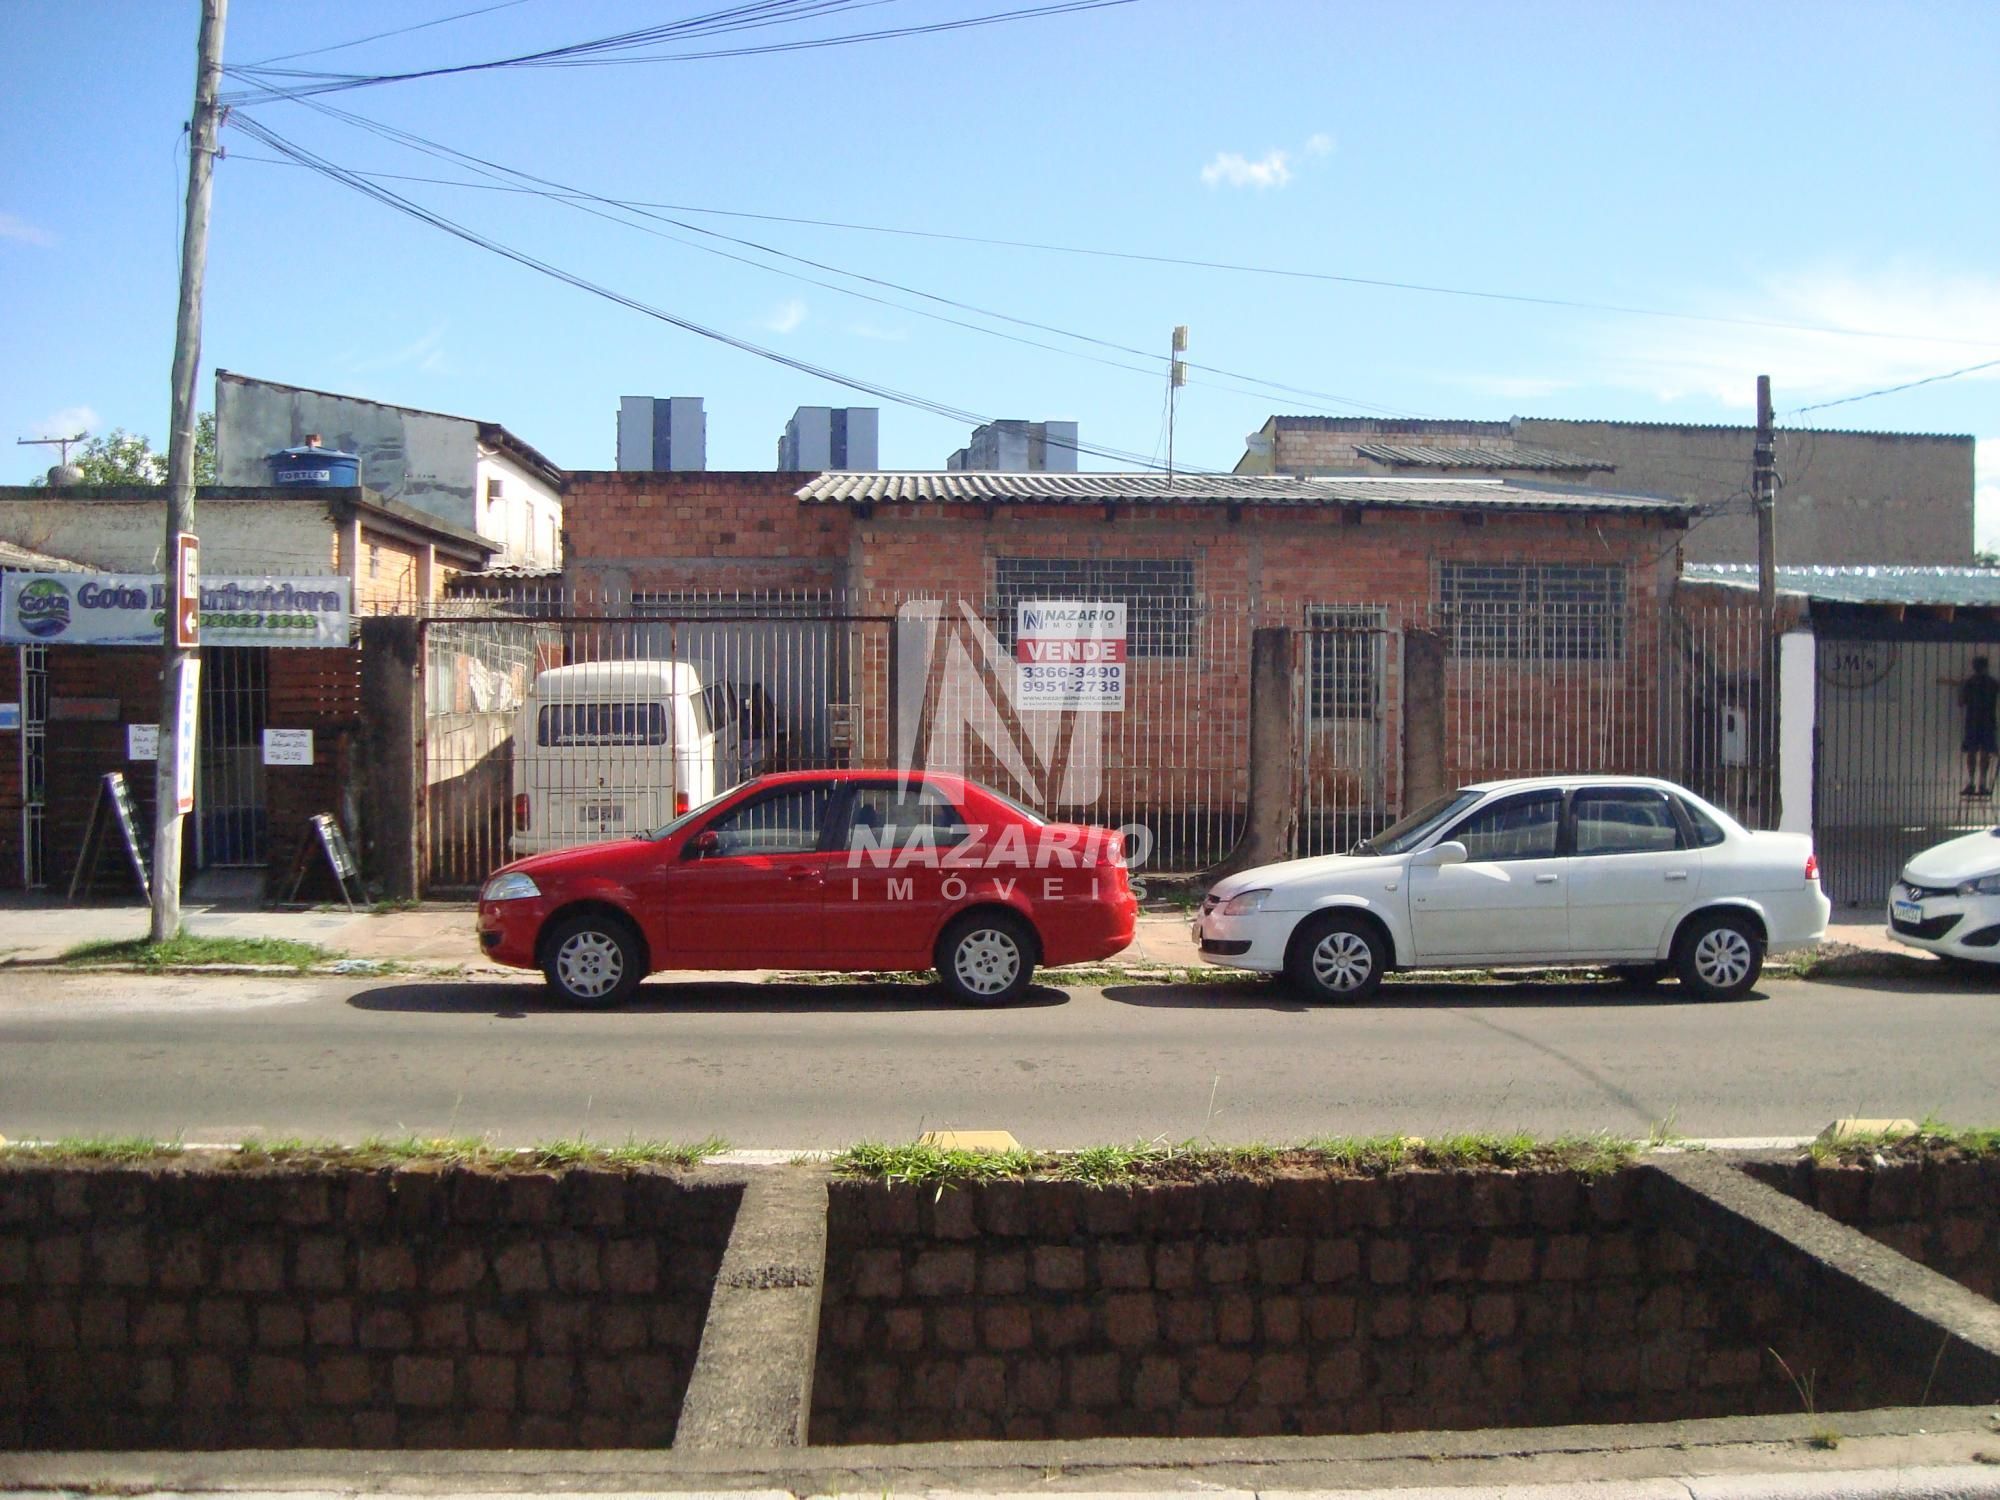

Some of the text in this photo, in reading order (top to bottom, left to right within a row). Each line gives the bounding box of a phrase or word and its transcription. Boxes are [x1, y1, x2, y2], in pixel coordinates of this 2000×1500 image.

[77, 582, 340, 612] Gota Dtribuidora
[1045, 610, 1115, 620] NAZARIO
[1026, 642, 1117, 660] VENDE
[1023, 666, 1120, 678] 3366-3490
[1023, 680, 1120, 692] 9951-2738
